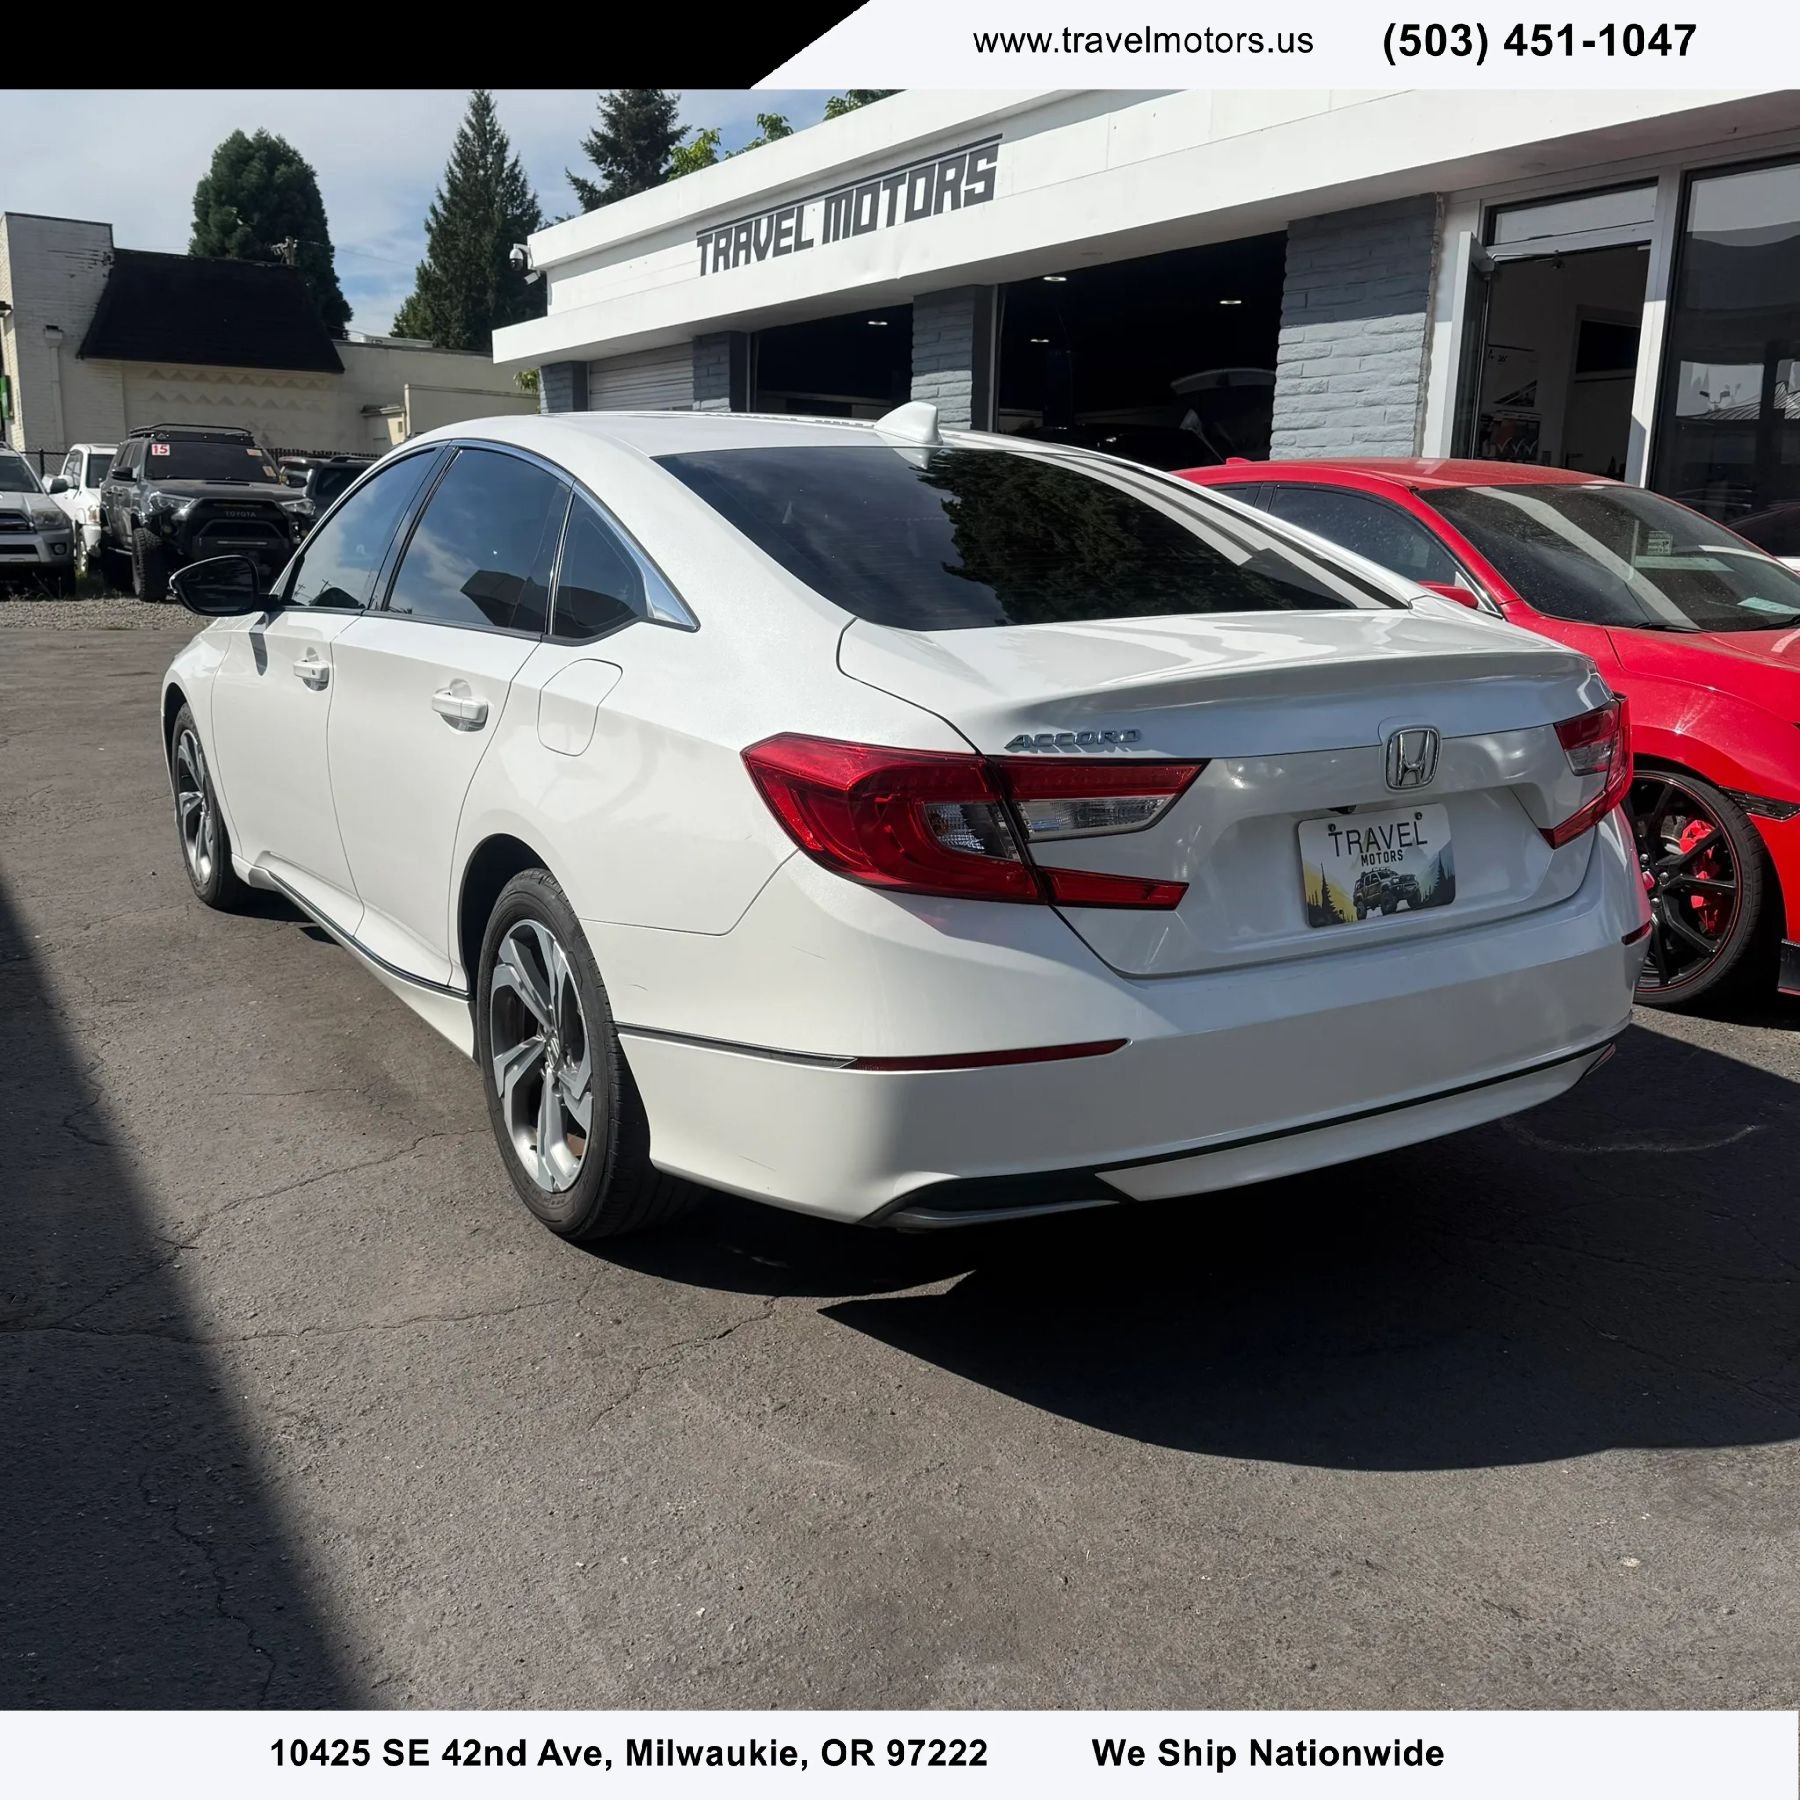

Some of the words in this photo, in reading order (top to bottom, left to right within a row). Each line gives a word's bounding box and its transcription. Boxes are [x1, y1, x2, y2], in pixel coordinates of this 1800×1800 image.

[696, 205, 814, 277] TRAVEL
[822, 143, 999, 245] MOTORS
[153, 445, 169, 454] 15
[1004, 728, 1143, 750] ACCORD
[1328, 821, 1428, 857] TRAVEL
[1360, 849, 1404, 867] MOTORS
